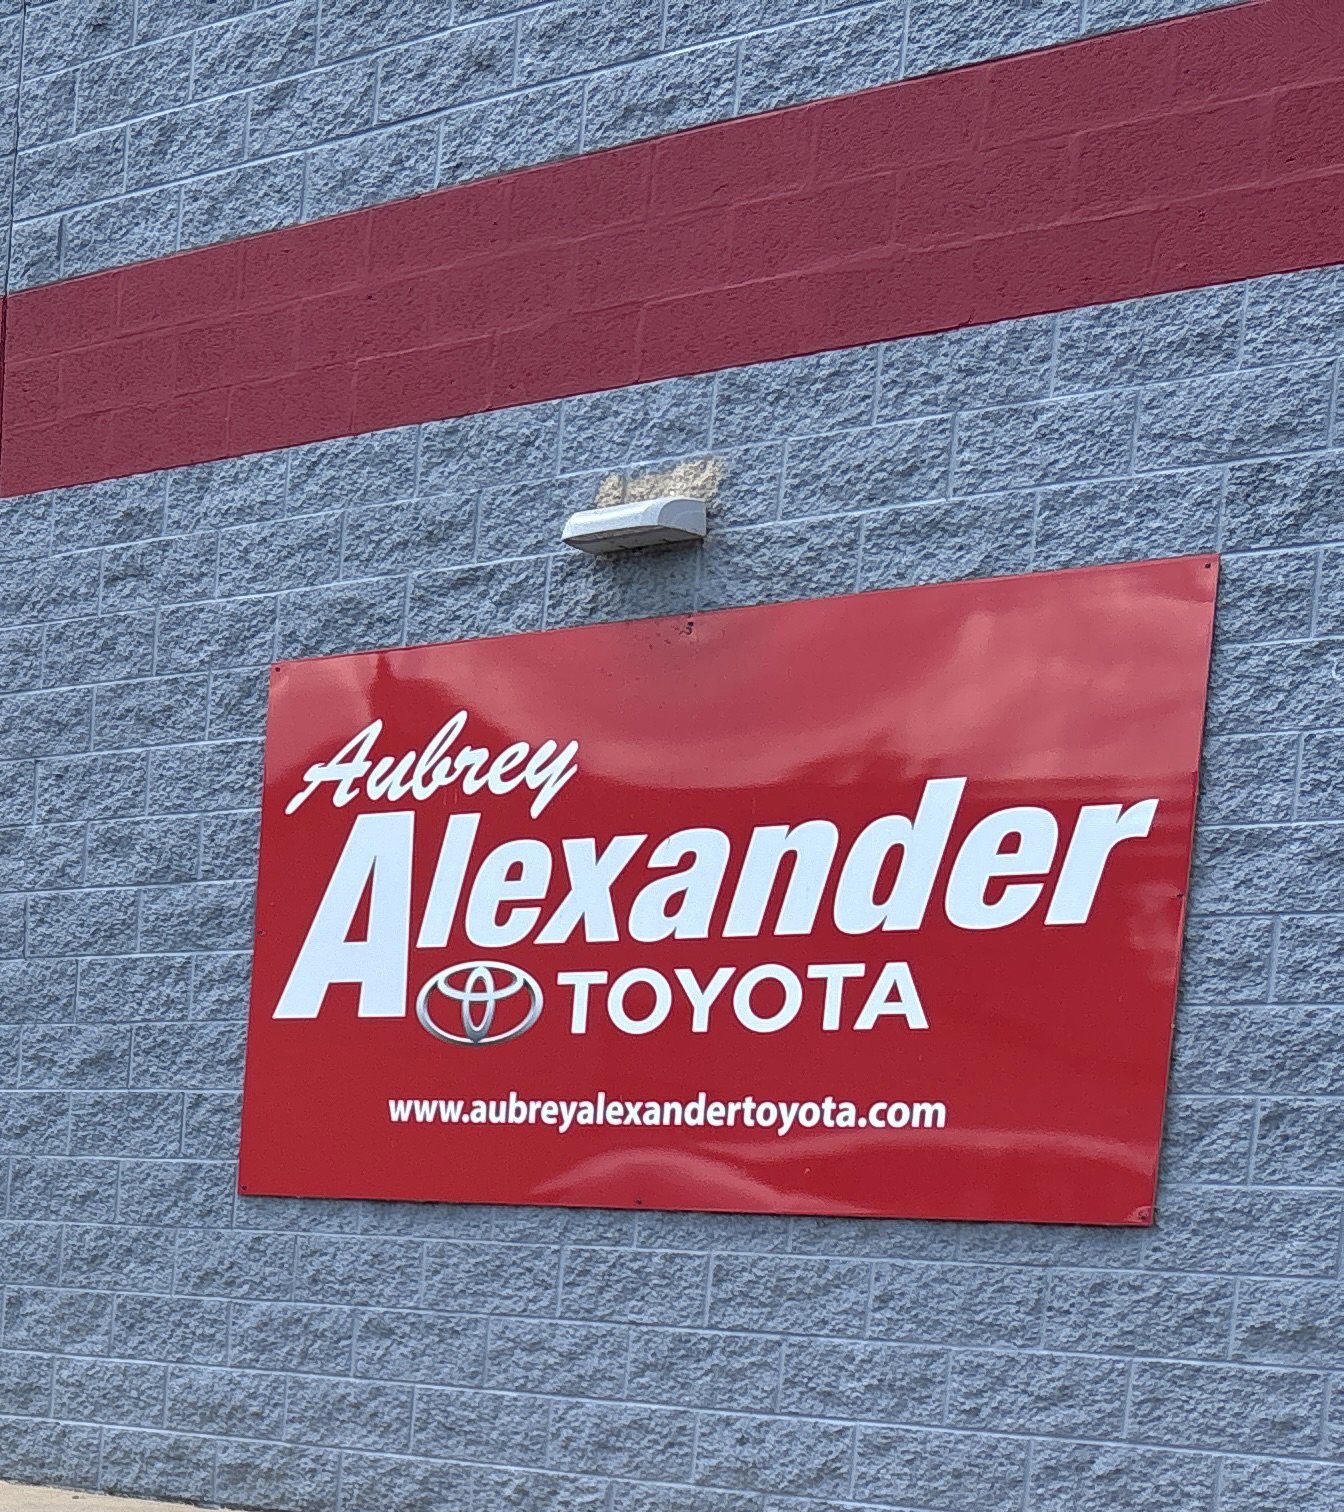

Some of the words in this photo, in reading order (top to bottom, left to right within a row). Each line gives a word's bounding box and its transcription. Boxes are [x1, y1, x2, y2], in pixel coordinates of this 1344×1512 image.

[286, 710, 579, 819] Aubrey
[273, 776, 1160, 1019] Alexander
[557, 961, 929, 1035] TOYOTA
[388, 1089, 946, 1137] www.aubreyalexandertoyota.com
